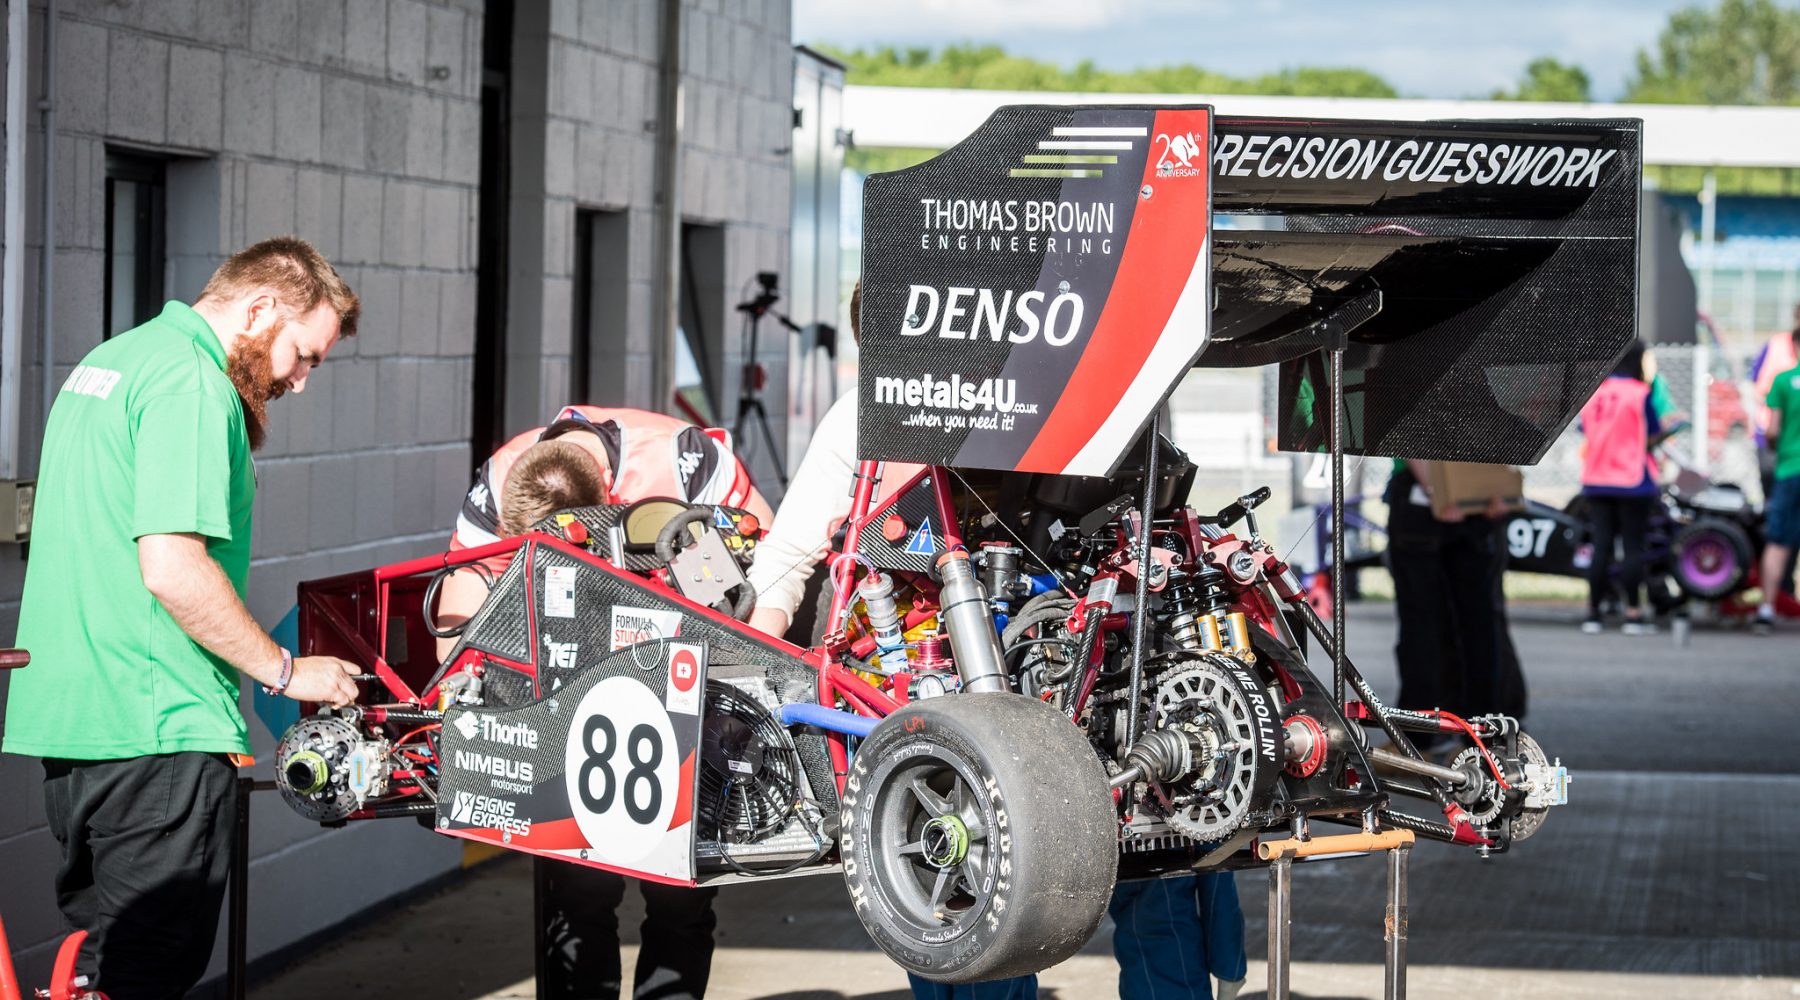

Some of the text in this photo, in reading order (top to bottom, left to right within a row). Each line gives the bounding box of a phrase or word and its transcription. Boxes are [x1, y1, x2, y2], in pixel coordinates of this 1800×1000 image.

[1156, 168, 1200, 178] ANVERSARY
[1383, 139, 1617, 188] GUESSWORK
[921, 199, 1114, 234] THOMAS BROWN
[921, 234, 1112, 255] ENGINEERING
[900, 284, 1084, 347] DENSO
[944, 414, 966, 433] you
[969, 411, 998, 430] need
[1002, 412, 1015, 431] it!
[1507, 518, 1556, 558] 97
[1233, 670, 1258, 691] ME
[480, 713, 538, 750] Thorite
[455, 749, 534, 781] NIMBUS
[578, 713, 664, 825] 88
[491, 779, 533, 795] motorsport
[474, 795, 516, 817] SIGNS
